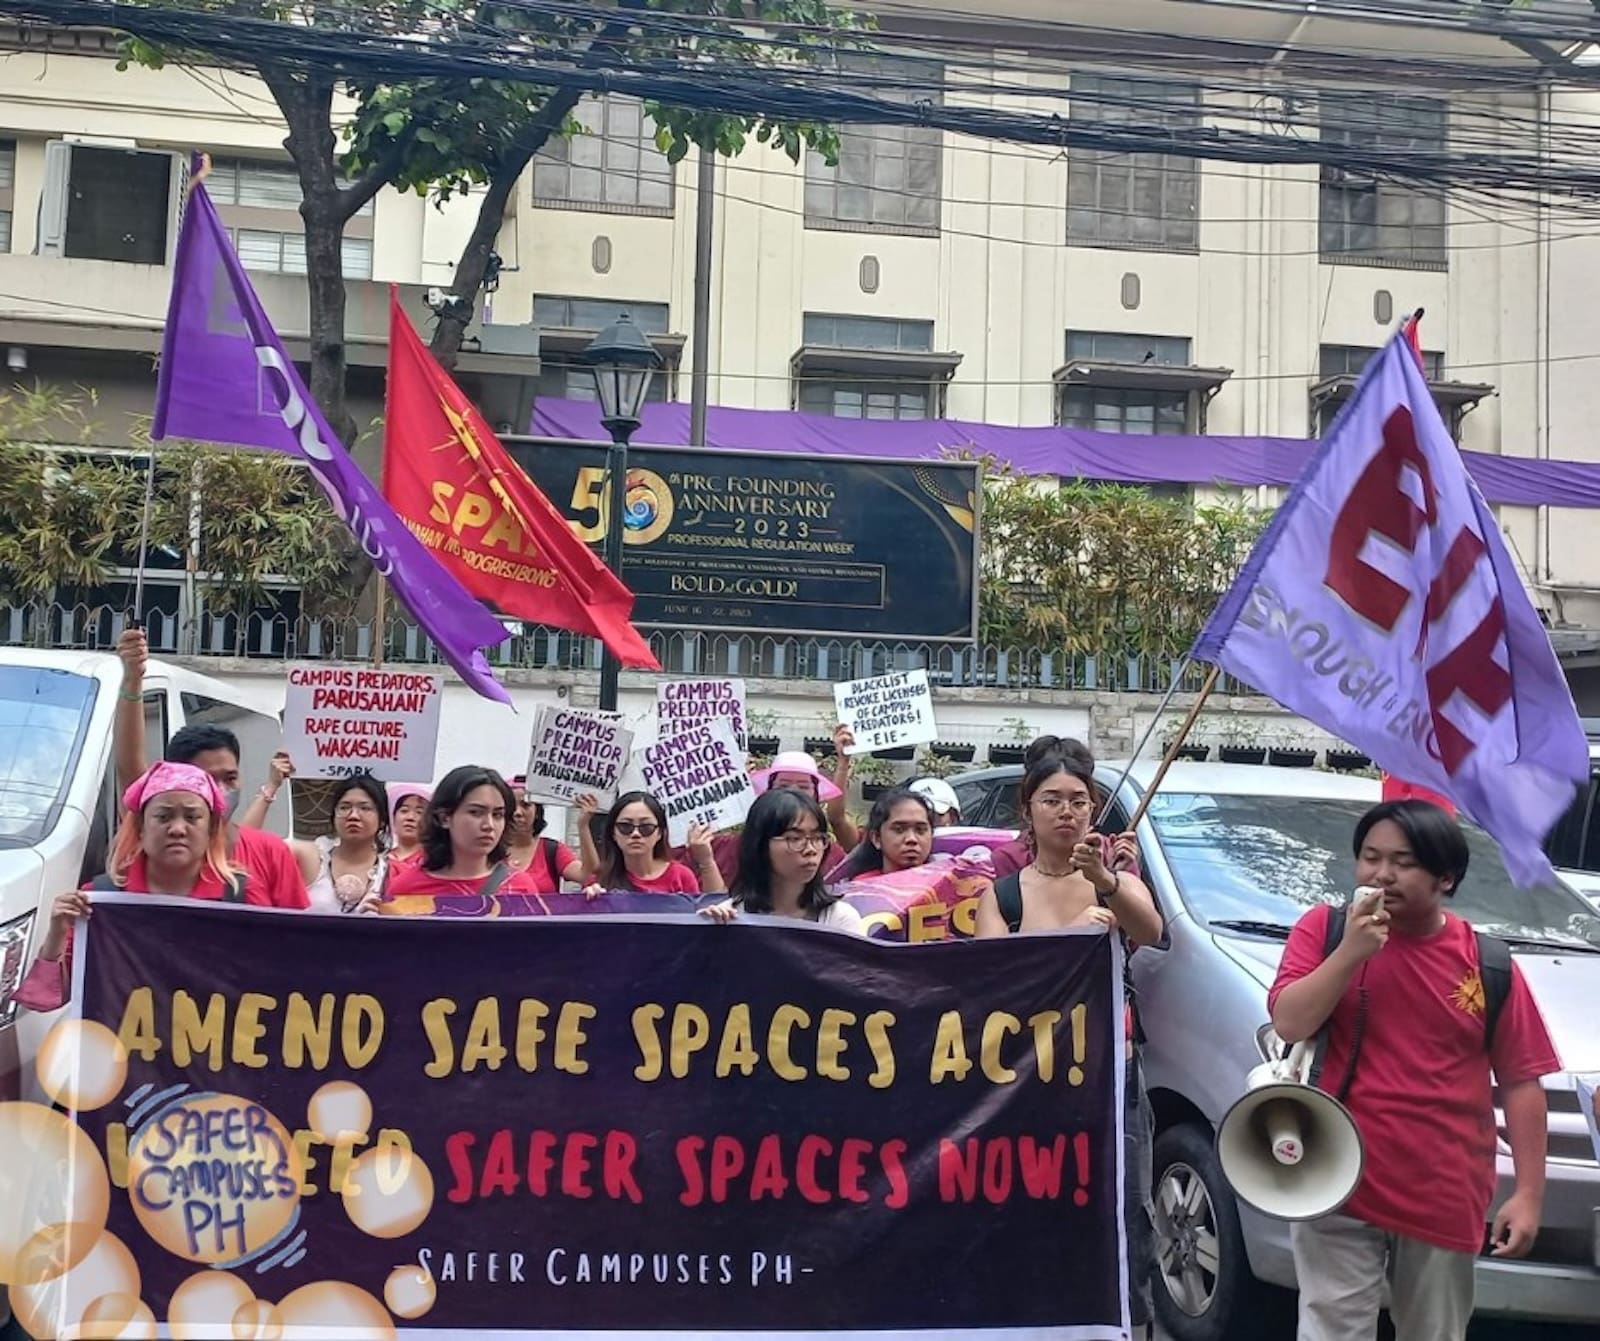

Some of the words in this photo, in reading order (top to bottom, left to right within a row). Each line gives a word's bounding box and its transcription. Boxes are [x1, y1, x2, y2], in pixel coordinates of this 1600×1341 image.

[682, 473, 722, 492] PRC
[727, 476, 836, 499] FOUNDING
[678, 493, 833, 519] ANNIVERSARY
[734, 518, 809, 538] 2023
[668, 533, 749, 549] PROFESSIONAL
[751, 537, 822, 553] REGULATION
[824, 541, 855, 555] WEEK
[671, 574, 725, 593] BOLD
[736, 578, 798, 598] GOLD!
[1239, 583, 1393, 710] ENOUGH
[290, 670, 353, 686] CAMPUS
[851, 672, 909, 695] BLACKLIST
[313, 688, 426, 713] PARUSAHAN!
[665, 682, 733, 700] CAMPUS
[844, 692, 881, 710] REVOKE
[882, 683, 927, 702] LICENSES
[658, 700, 741, 718] PREDATOR
[853, 709, 922, 733] PREDATORS!
[856, 707, 870, 719] OF
[871, 700, 912, 717] CAMPUS
[305, 718, 341, 735] RAPE
[343, 719, 408, 738] CULTURE,
[554, 713, 617, 742] CAMPUS
[659, 723, 670, 735] AT
[315, 738, 400, 761] WAKASAN!
[543, 728, 622, 762] PREDATOR
[645, 727, 713, 764] CAMPUS
[533, 760, 618, 791] PARUSAHAN!
[549, 747, 617, 779] ENABLER
[642, 741, 731, 786] PREDATOR
[663, 758, 738, 798] ENABLER
[115, 988, 386, 1072] AMEND
[421, 997, 597, 1079] SAFE
[631, 1002, 897, 1089] SPACES
[929, 1003, 1089, 1086] ACT!
[444, 1129, 643, 1204] SAFER
[675, 1134, 910, 1209] SPACES
[938, 1131, 1090, 1207] NOW!
